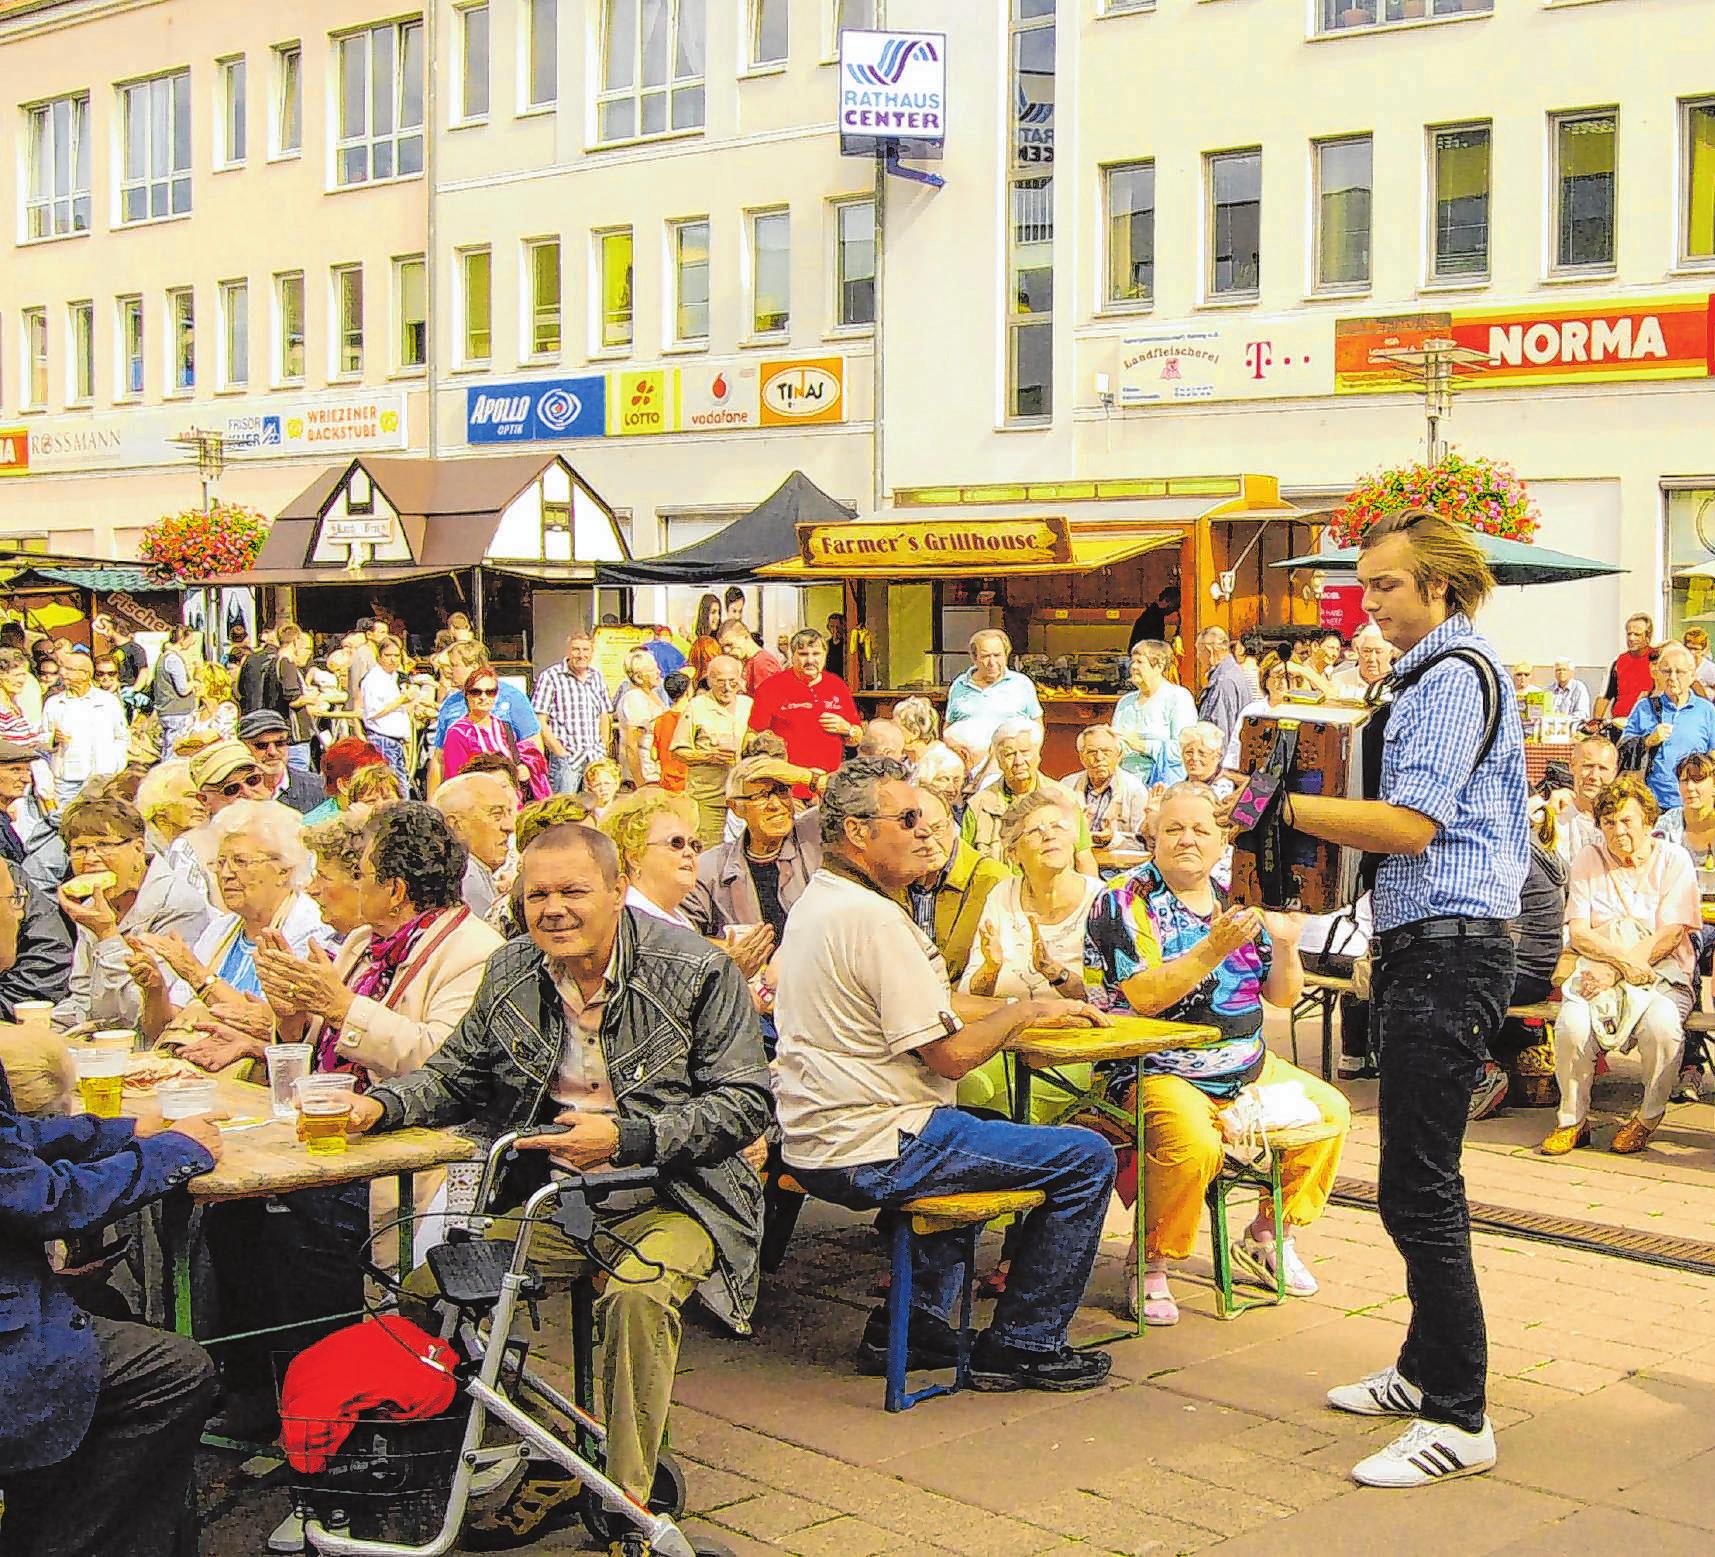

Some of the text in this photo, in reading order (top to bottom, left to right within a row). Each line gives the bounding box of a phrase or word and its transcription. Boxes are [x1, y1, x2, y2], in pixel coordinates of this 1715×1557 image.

[845, 90, 940, 109] RATHAUS
[845, 110, 939, 128] CENTER
[1489, 316, 1668, 366] NORMA
[307, 406, 376, 424] WRIEZENER
[470, 394, 531, 425] APOLLO
[625, 411, 660, 426] LOTTO
[692, 410, 748, 425] vodafone
[307, 424, 376, 441] BACKSTUBE
[497, 424, 524, 436] OPTIK
[32, 429, 121, 455] ROSSMANN
[924, 532, 1039, 553] Grillhouse
